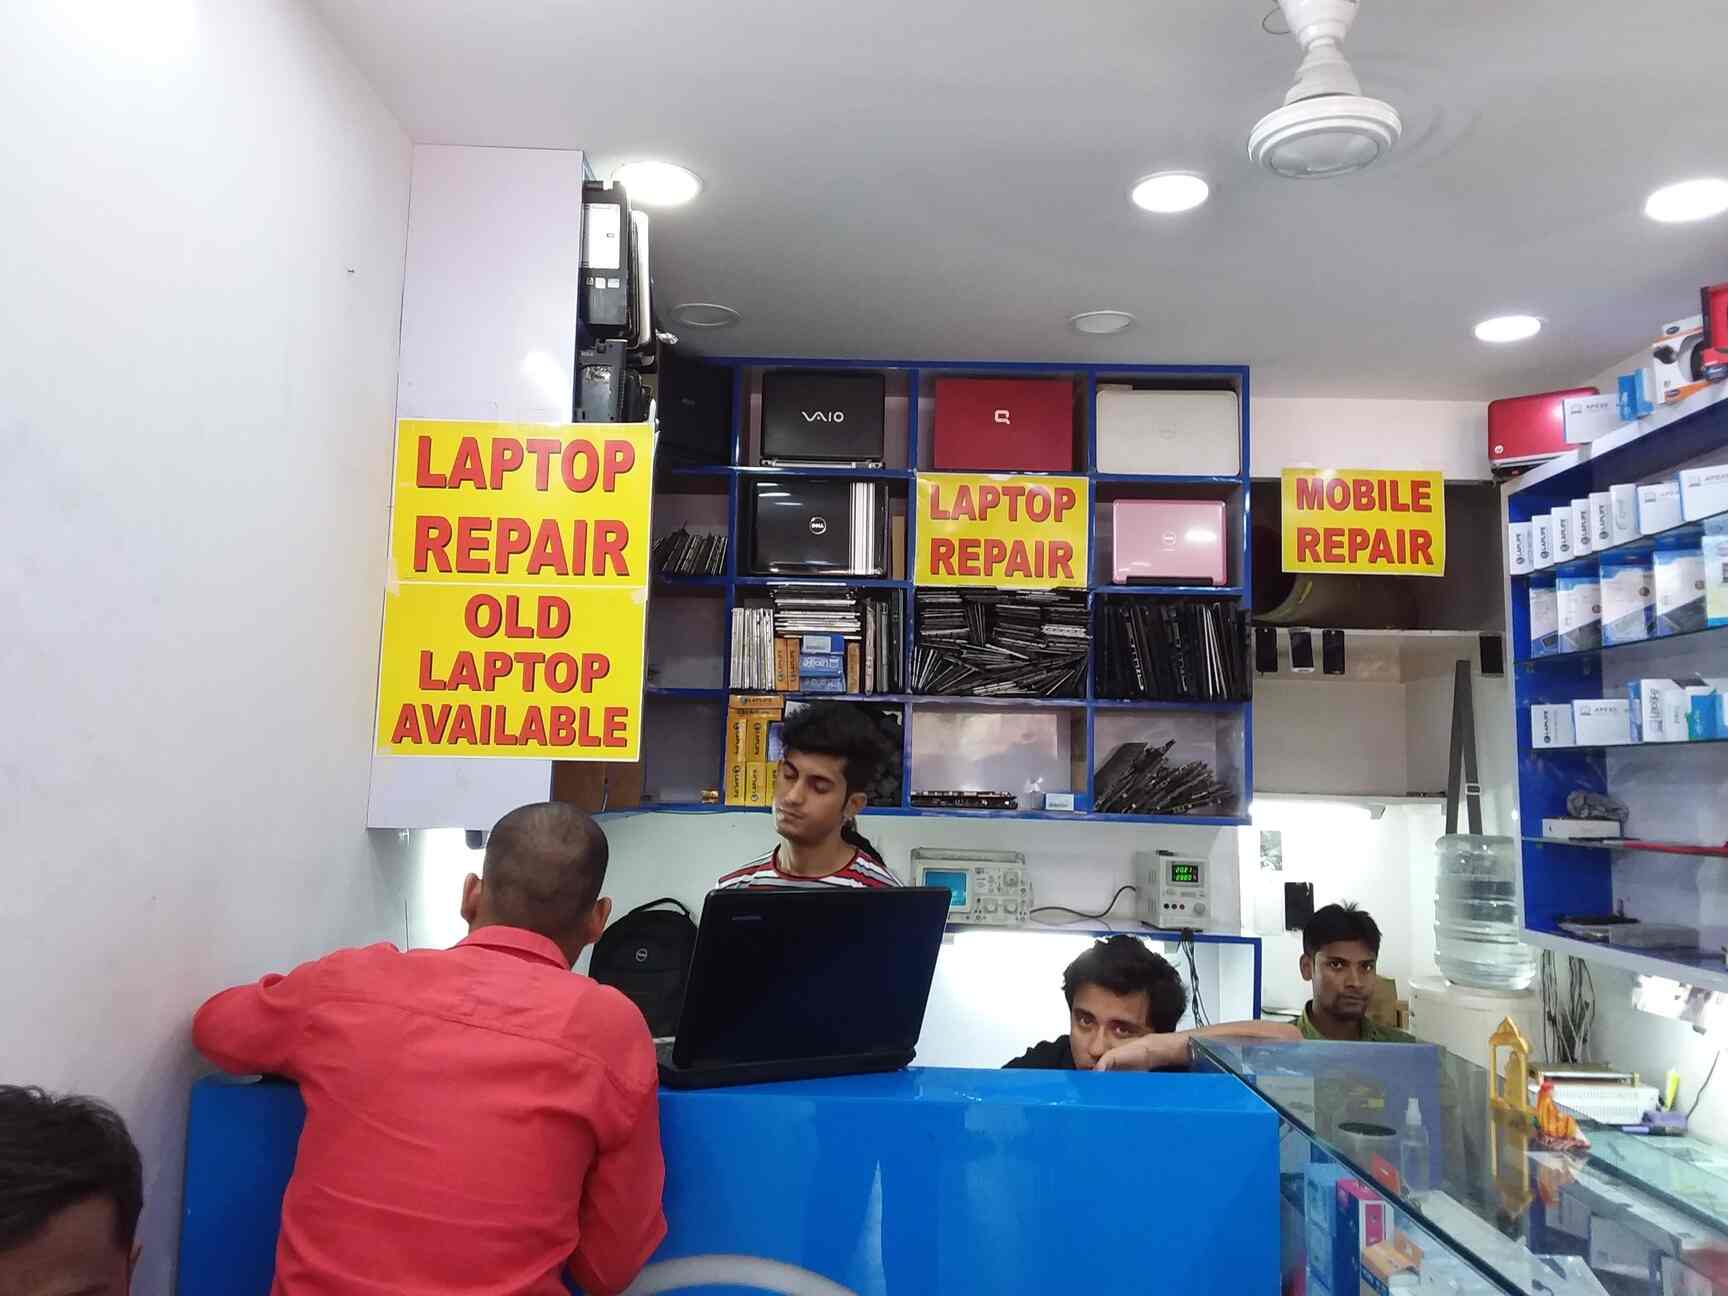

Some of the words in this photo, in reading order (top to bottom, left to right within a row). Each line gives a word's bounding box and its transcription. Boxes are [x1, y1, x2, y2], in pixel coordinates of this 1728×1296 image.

[801, 411, 845, 423] VAIO
[415, 435, 636, 493] LAPTOP
[930, 484, 1077, 523] LAPTOP
[1296, 478, 1433, 513] MOBILE
[413, 515, 631, 577] REPAIR
[930, 537, 1074, 579] REPAIR
[1296, 527, 1434, 566] REPAIR
[464, 593, 571, 639] OLD
[418, 650, 611, 693] LAPTOP
[391, 703, 629, 748] AVAILABLE
